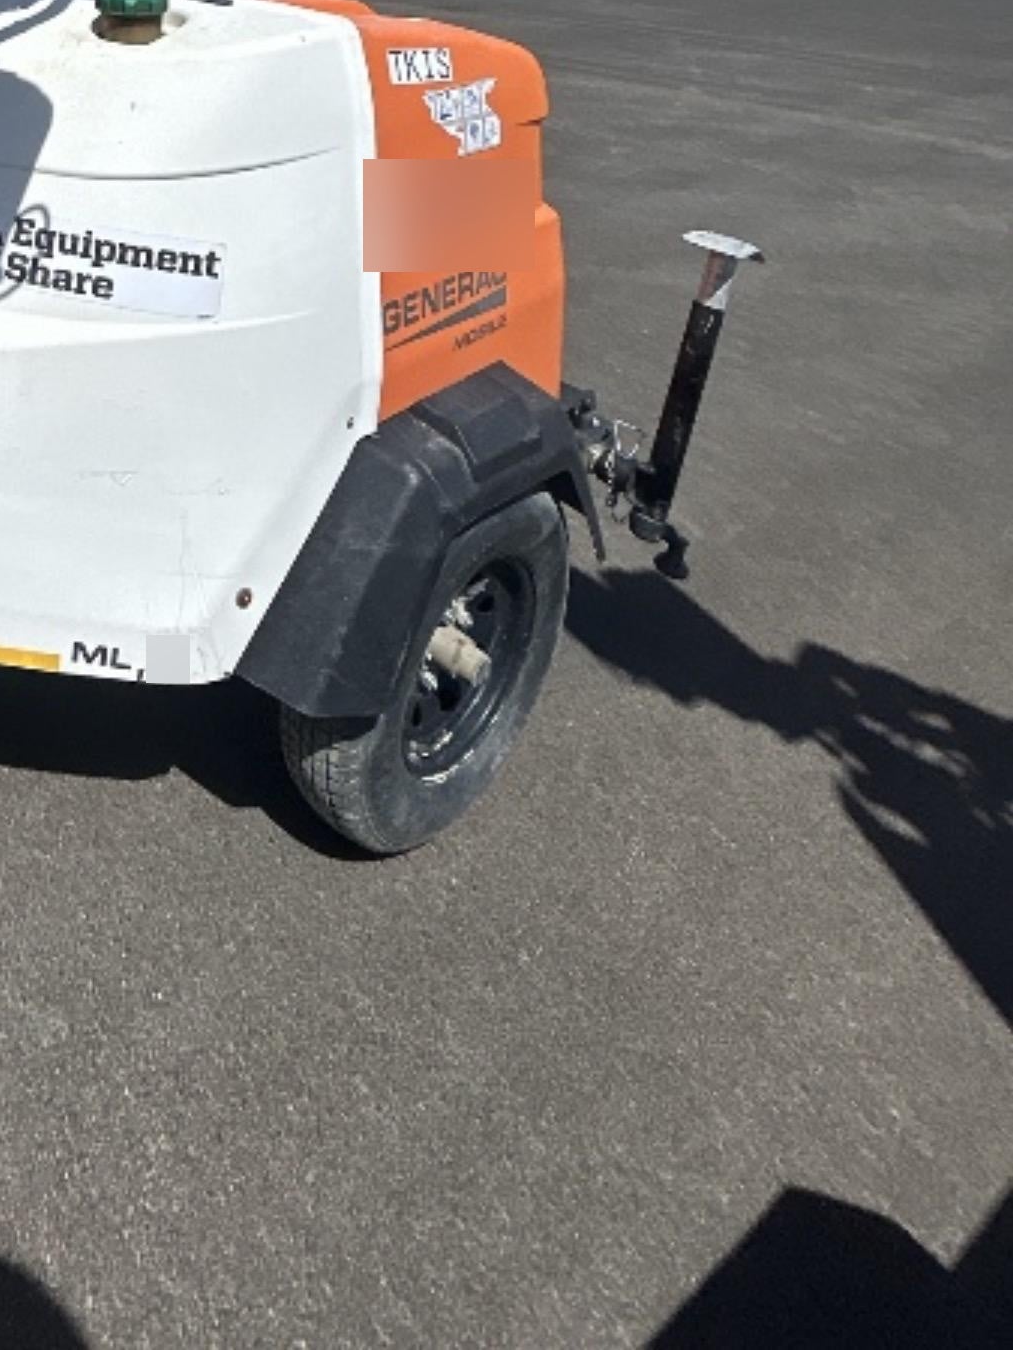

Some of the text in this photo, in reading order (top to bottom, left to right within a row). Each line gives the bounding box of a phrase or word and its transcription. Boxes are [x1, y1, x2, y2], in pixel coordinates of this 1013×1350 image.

[388, 48, 450, 82] TKIS
[10, 216, 221, 279] Equipment
[4, 252, 114, 299] Share
